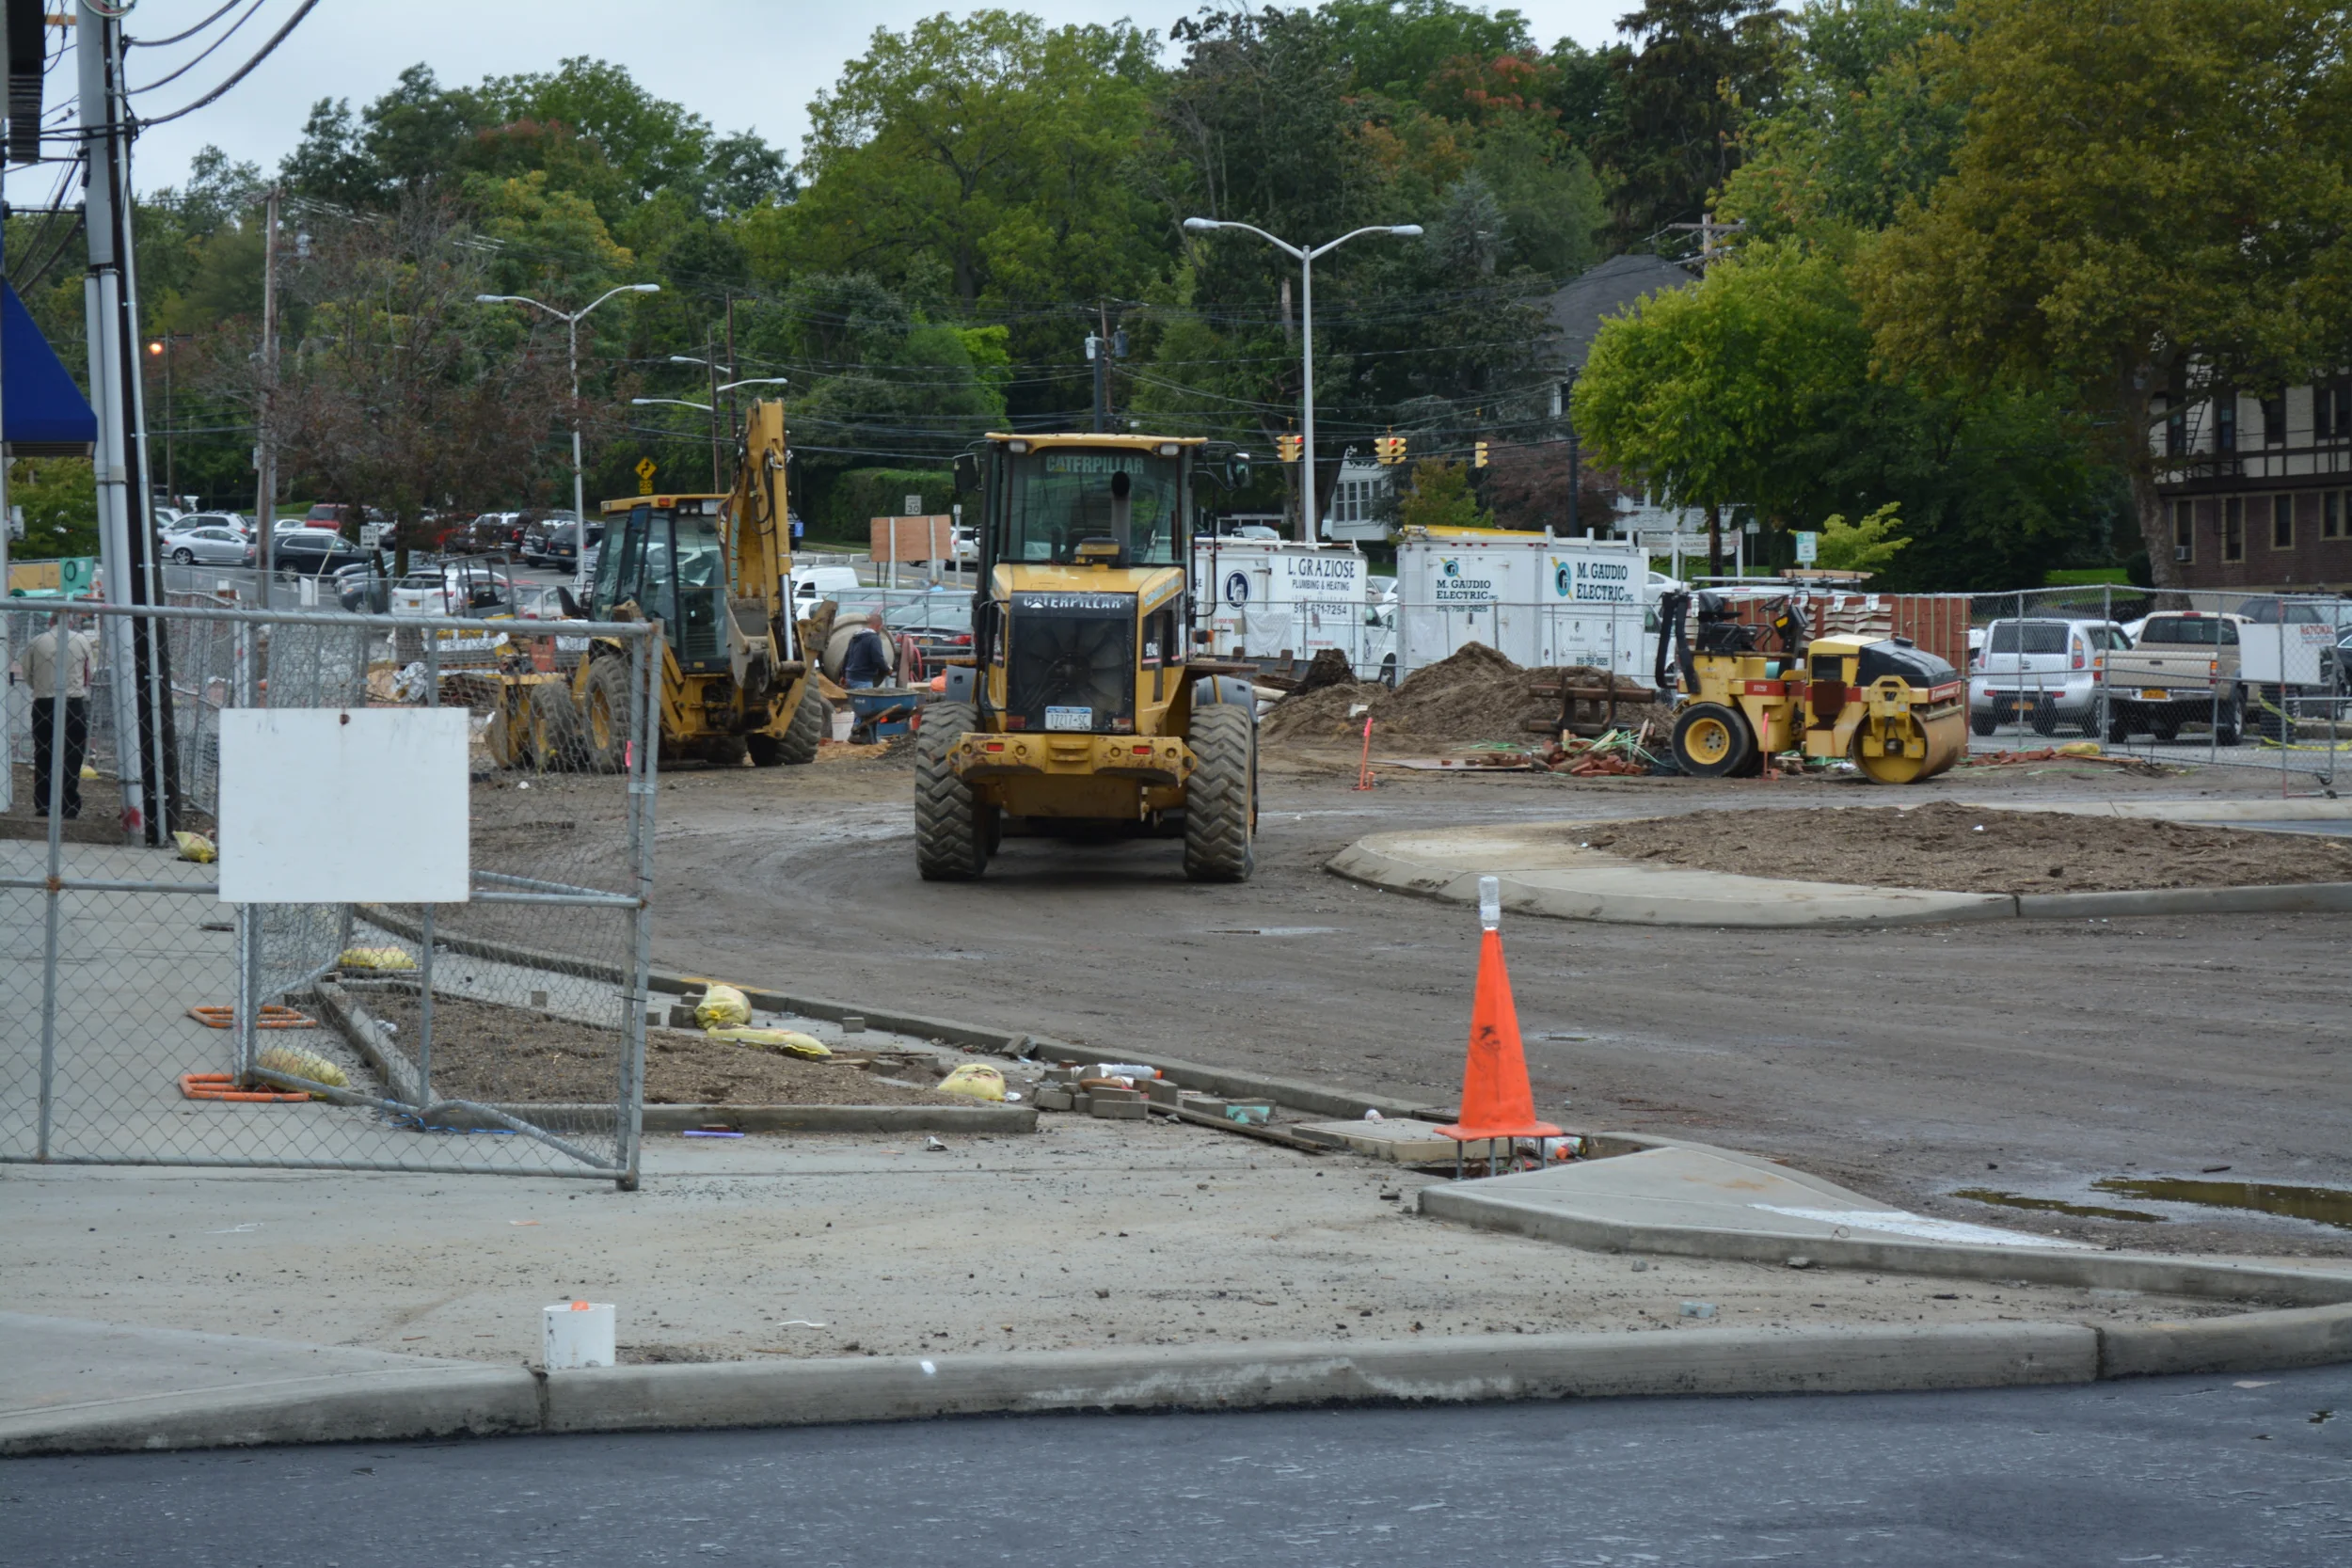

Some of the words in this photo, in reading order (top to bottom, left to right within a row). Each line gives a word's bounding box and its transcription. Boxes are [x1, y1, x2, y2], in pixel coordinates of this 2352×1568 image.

[1046, 455, 1144, 474] CATERPILLAR
[1287, 557, 1296, 576] L.
[1298, 558, 1355, 578] GRAZIOSE
[1577, 562, 1589, 578] M.
[1590, 562, 1628, 580] GAUDIO
[1292, 579, 1320, 590] PLUMBING
[1321, 580, 1325, 590] &
[1327, 581, 1350, 591] HEATING
[1437, 579, 1449, 589] M.
[1451, 579, 1491, 589] GAUDIO
[1437, 591, 1488, 599] ELECTRIC
[1577, 583, 1625, 601] ELECTRIC
[1023, 596, 1121, 609] CATERPILLAR
